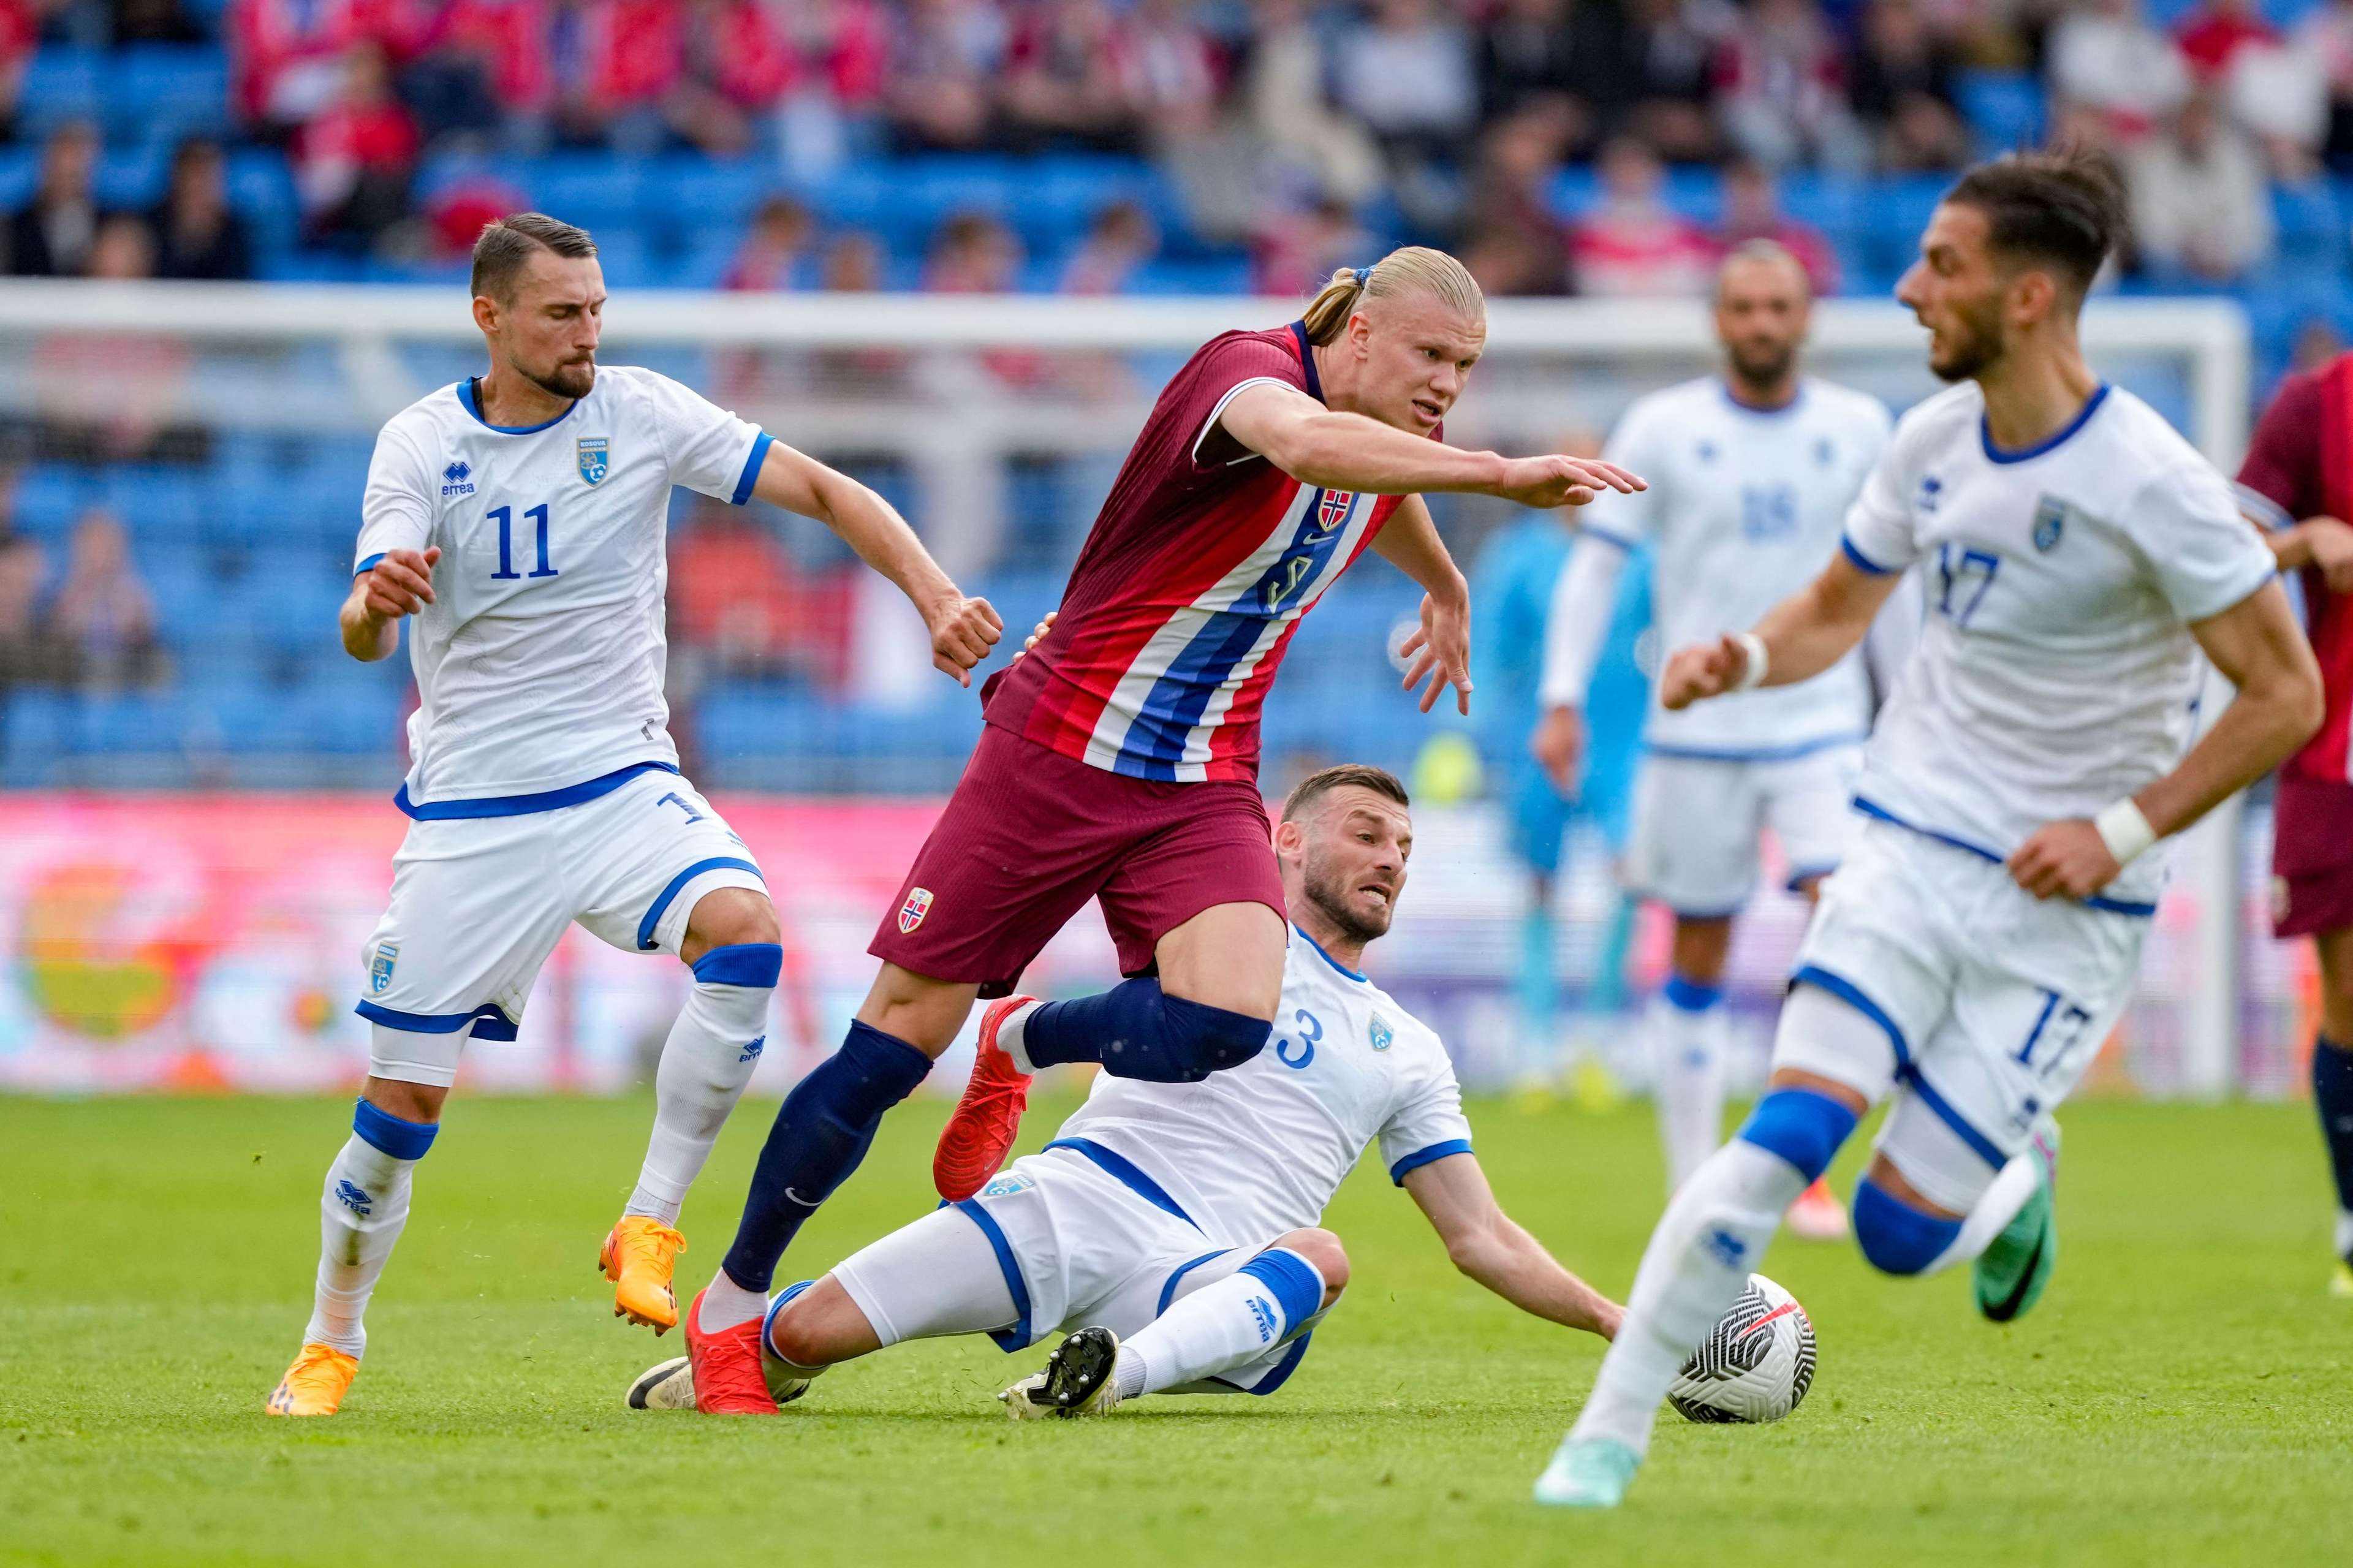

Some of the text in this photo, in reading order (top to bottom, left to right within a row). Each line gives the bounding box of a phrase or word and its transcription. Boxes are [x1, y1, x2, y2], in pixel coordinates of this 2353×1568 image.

[487, 504, 559, 579] 11
[1936, 541, 1999, 629] 17
[1276, 1009, 1323, 1069] 3
[2006, 985, 2093, 1080] 17
